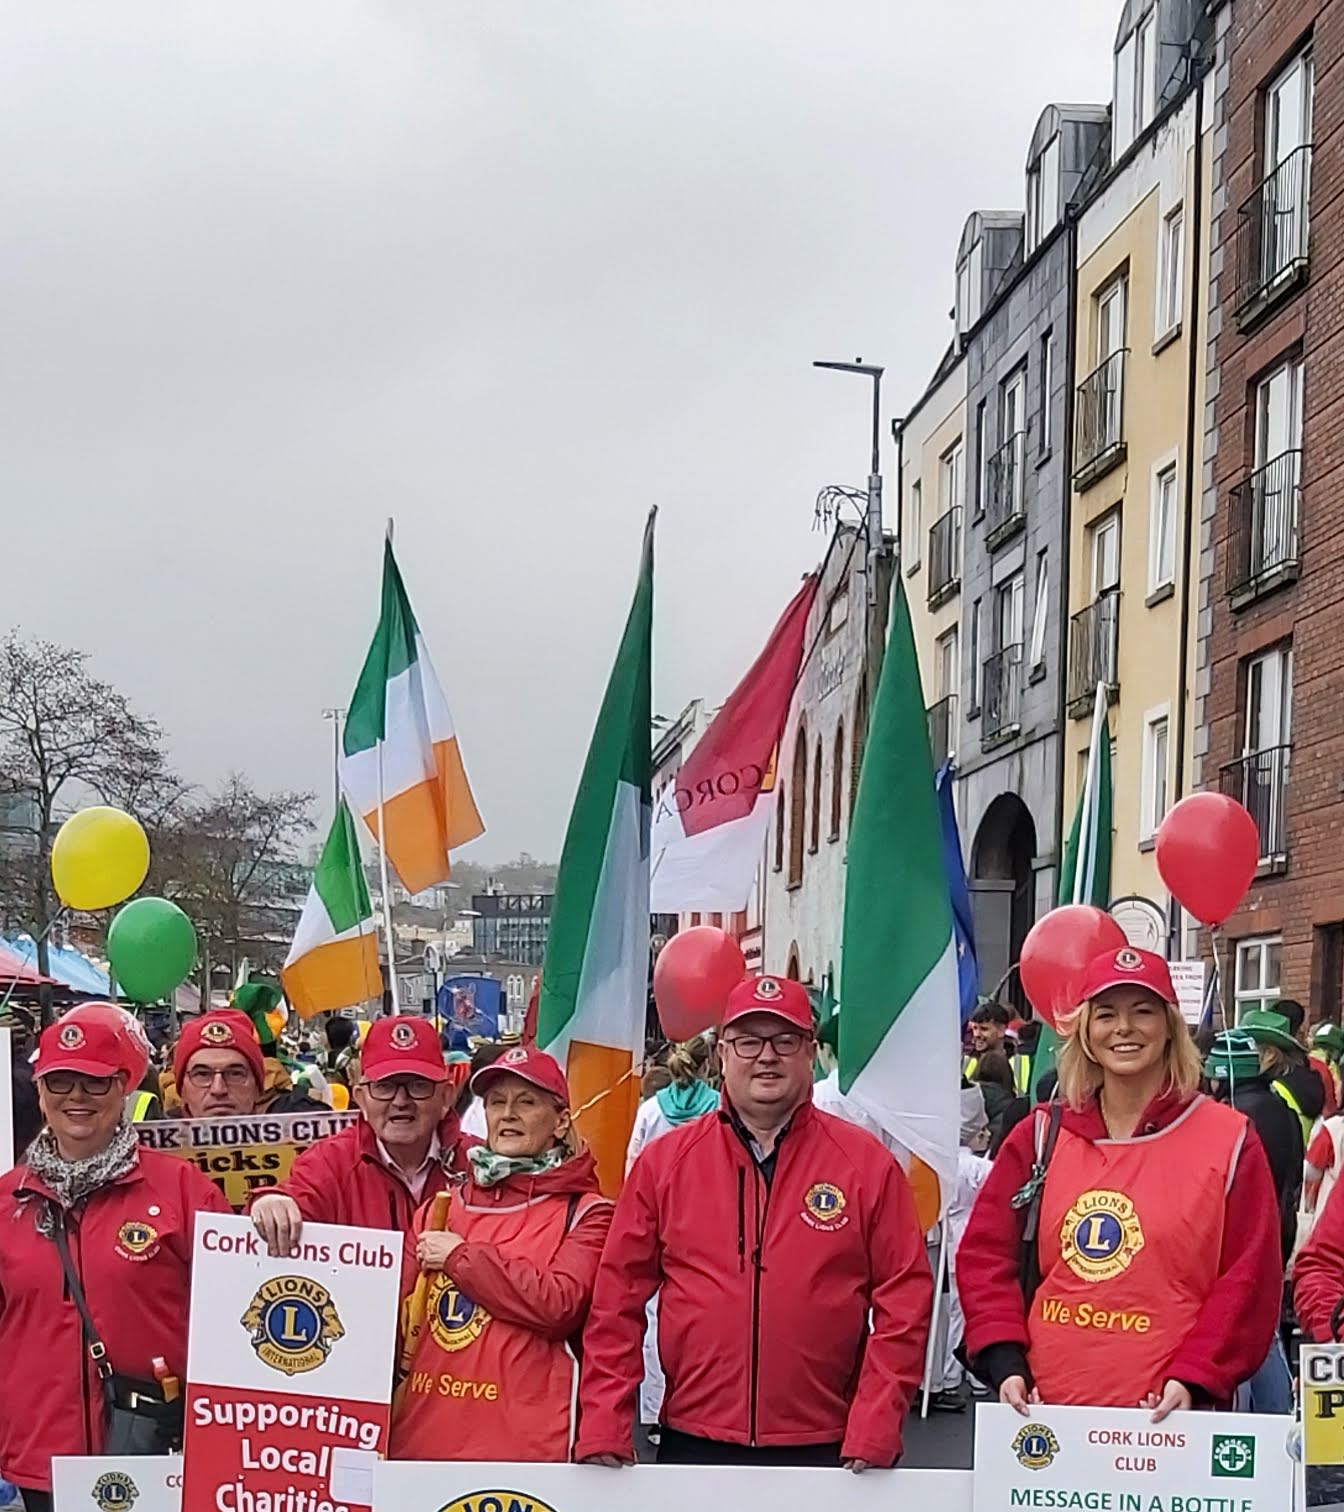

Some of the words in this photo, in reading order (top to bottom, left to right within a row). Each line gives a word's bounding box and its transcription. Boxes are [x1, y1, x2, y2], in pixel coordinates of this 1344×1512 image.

[192, 1122, 281, 1146] LIONS
[1083, 1196, 1128, 1213] LIONS
[203, 1229, 259, 1256] Cork
[339, 1242, 393, 1269] Club
[264, 1278, 328, 1303] LIONS
[281, 1307, 307, 1343] L
[1042, 1300, 1070, 1323] We
[1075, 1303, 1150, 1332] Serve
[411, 1371, 433, 1394] We
[438, 1375, 497, 1400] Serve
[193, 1398, 381, 1450] Supporting
[1088, 1429, 1133, 1446] CORK
[1137, 1431, 1186, 1448] LIONS
[242, 1439, 328, 1477] Local
[1114, 1456, 1157, 1472] CLUB
[1010, 1488, 1112, 1512] MESSAGE
[1119, 1493, 1143, 1512] IN
[1149, 1495, 1164, 1512] A
